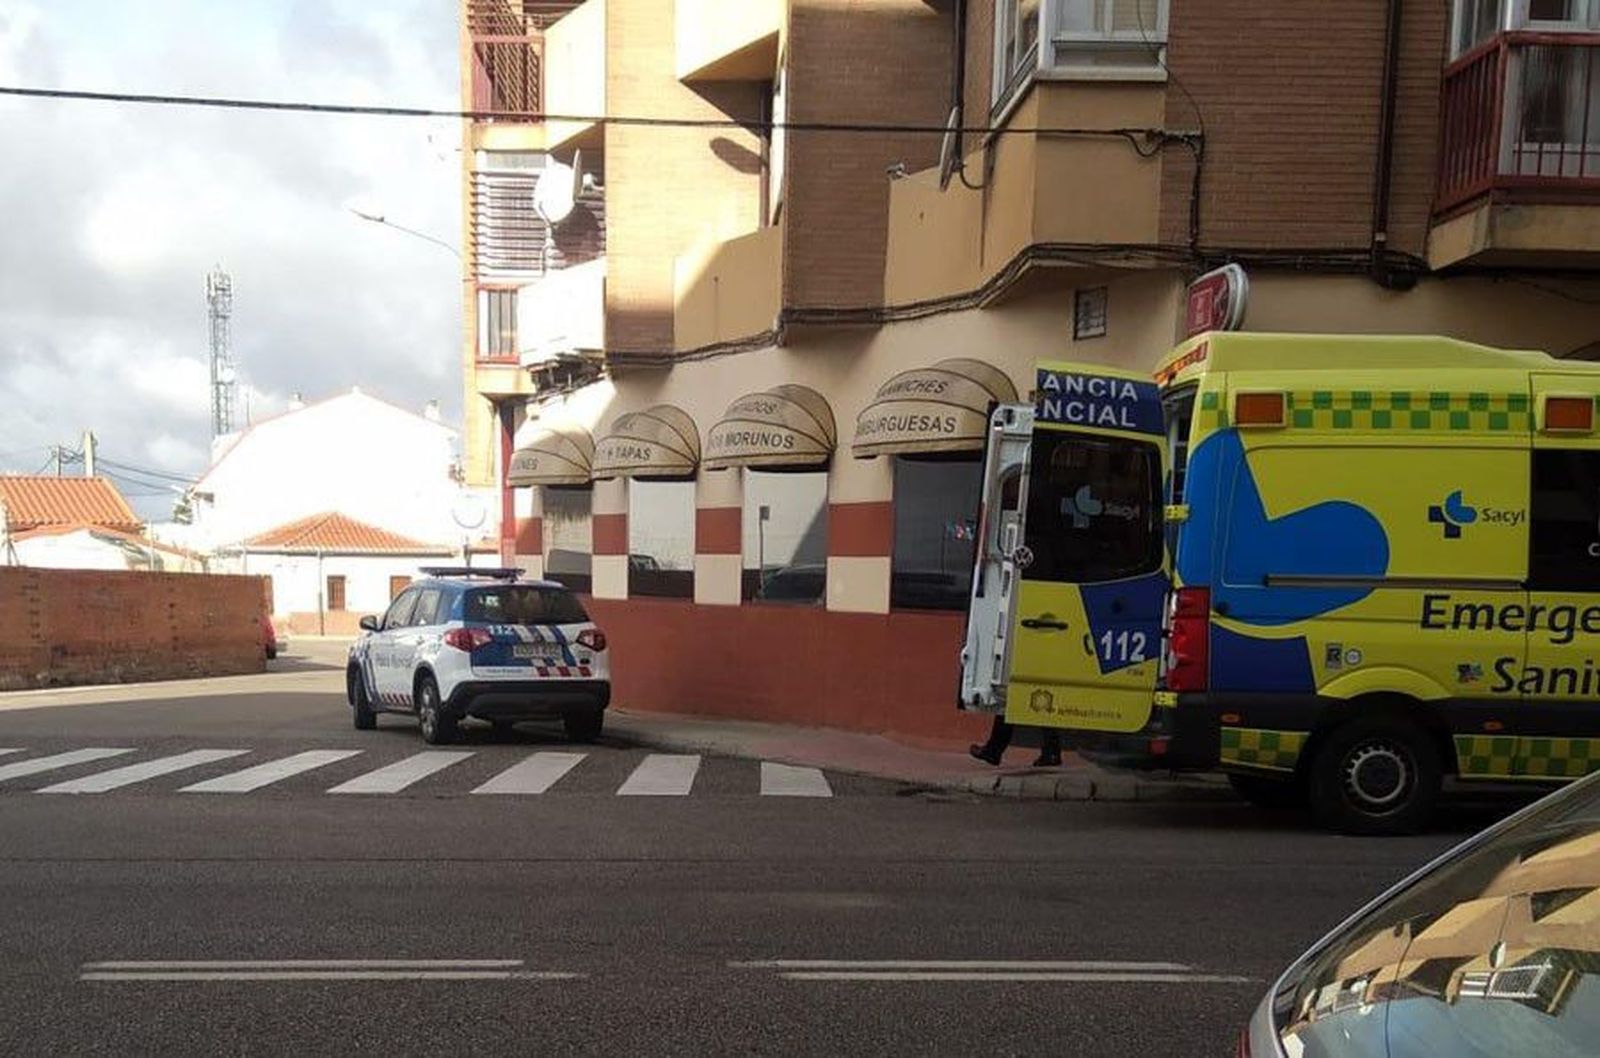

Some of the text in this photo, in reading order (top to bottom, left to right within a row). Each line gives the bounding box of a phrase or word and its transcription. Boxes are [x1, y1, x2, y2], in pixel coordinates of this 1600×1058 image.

[1043, 374, 1138, 402] ANCIA
[1482, 508, 1525, 525] Sacyl
[1421, 594, 1600, 644] Emerge
[1101, 630, 1146, 662] 112
